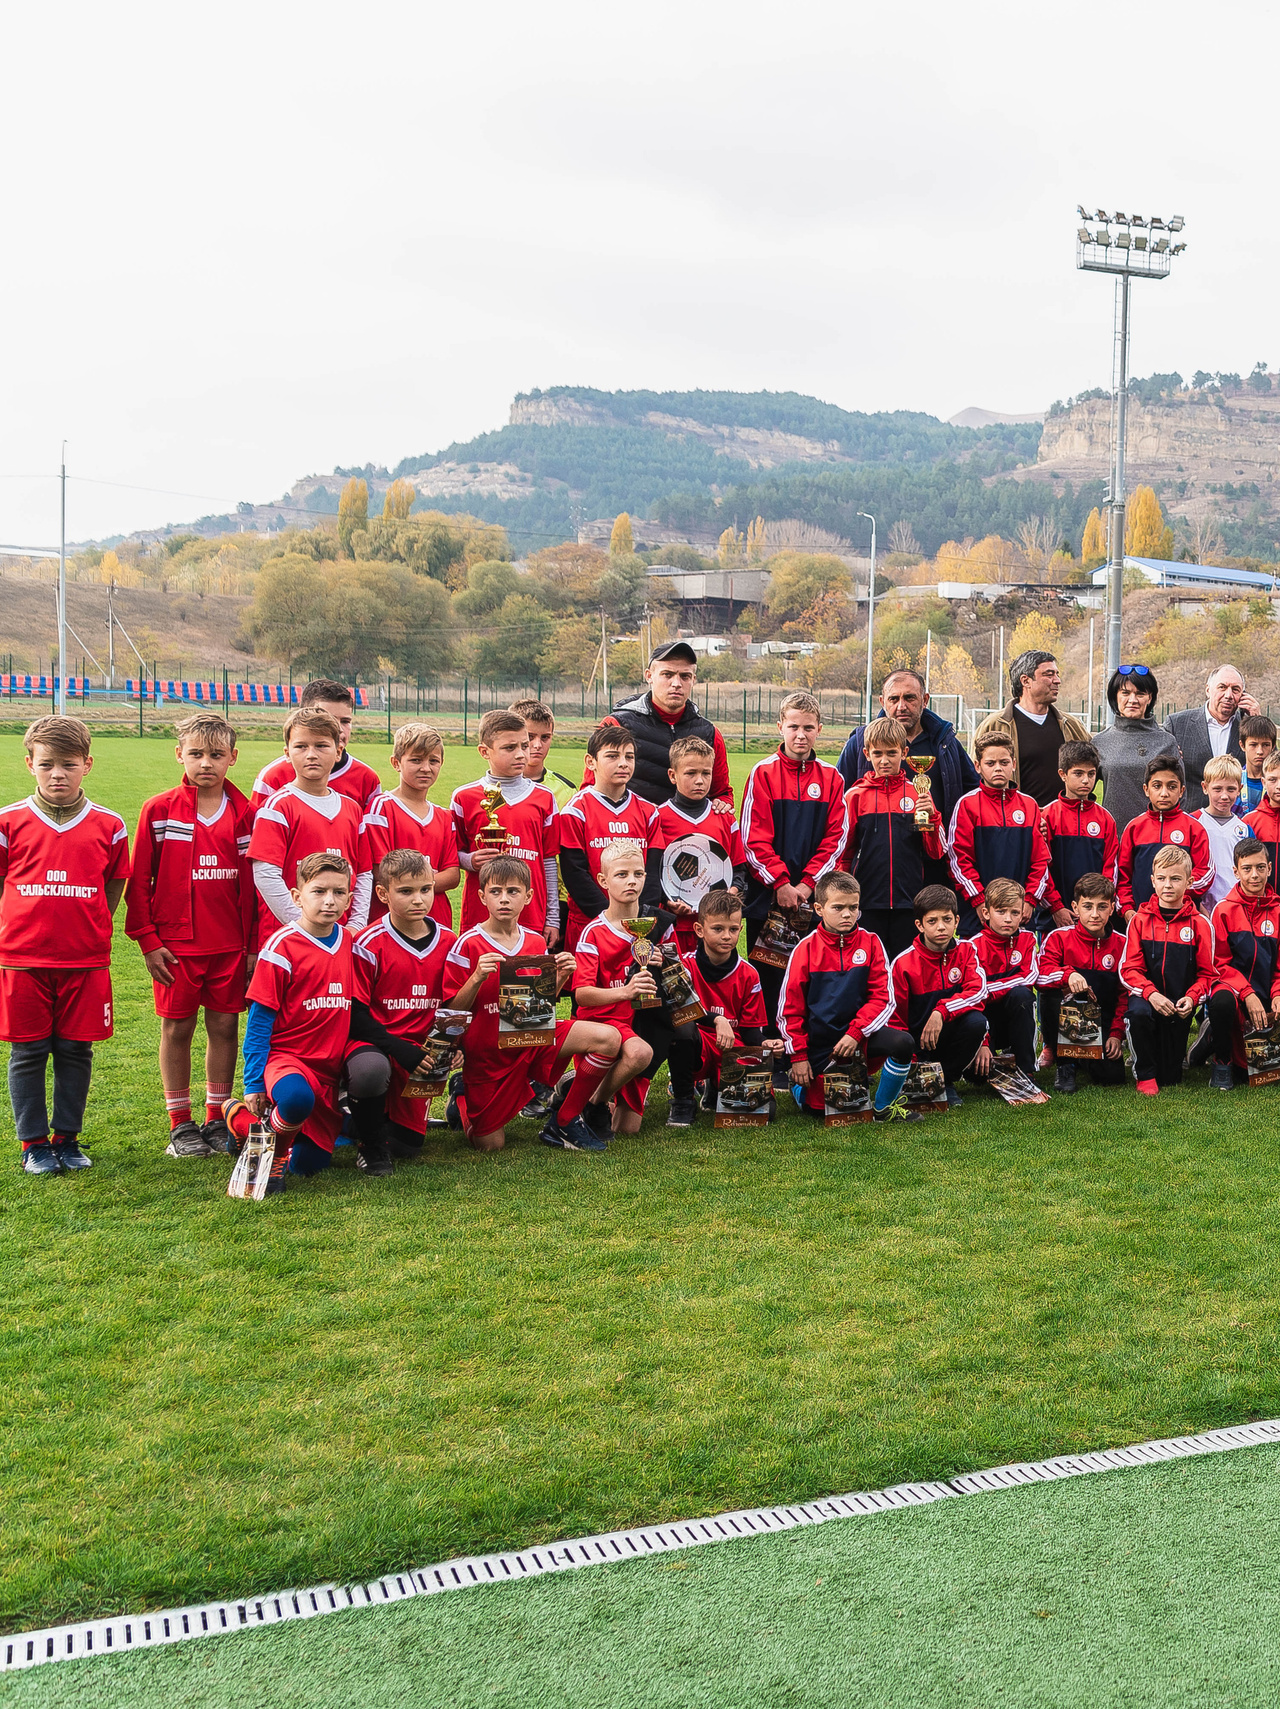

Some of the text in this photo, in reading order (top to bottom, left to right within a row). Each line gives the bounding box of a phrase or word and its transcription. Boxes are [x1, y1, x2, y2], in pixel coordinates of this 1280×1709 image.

[608, 821, 629, 834] ООО
[199, 855, 218, 867] ООО
[46, 869, 67, 882] ООО
[103, 1002, 111, 1027] 5
